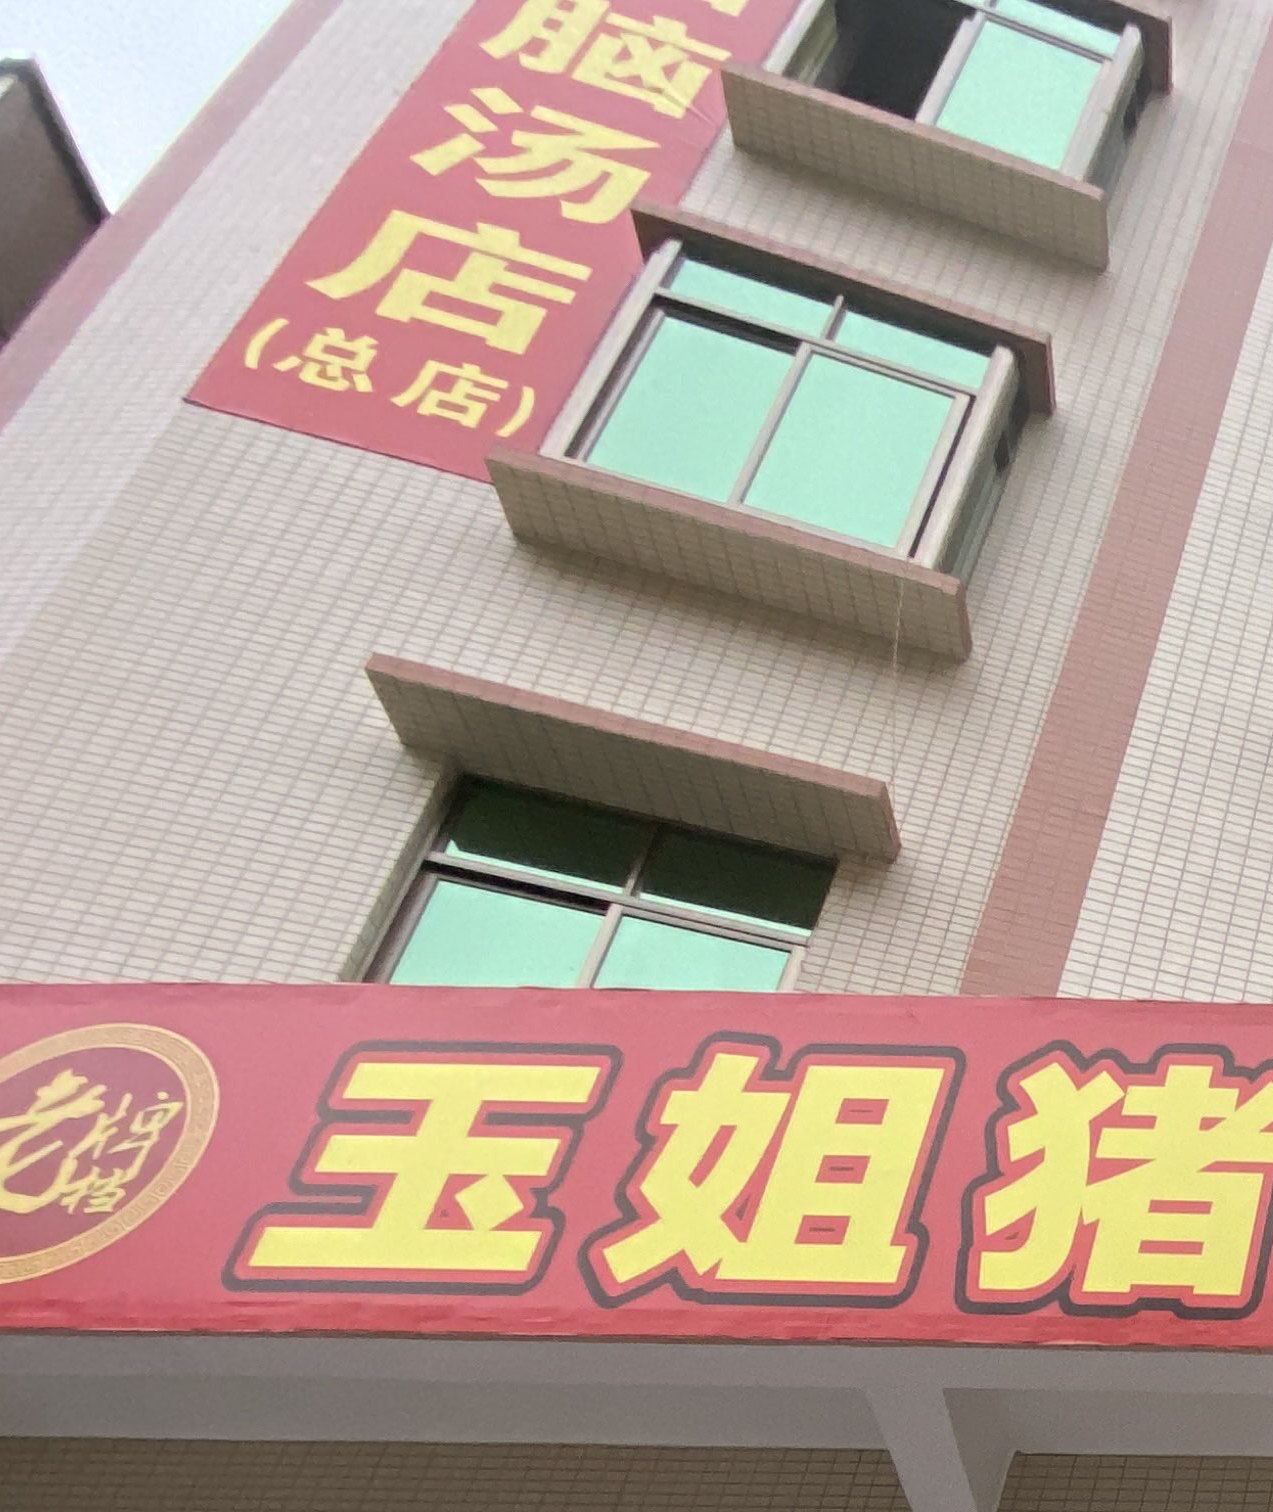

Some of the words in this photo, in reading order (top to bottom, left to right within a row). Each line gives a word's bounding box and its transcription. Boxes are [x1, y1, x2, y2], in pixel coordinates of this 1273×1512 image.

[307, 0, 746, 354] 脑汤店
[244, 318, 535, 437] (总店)
